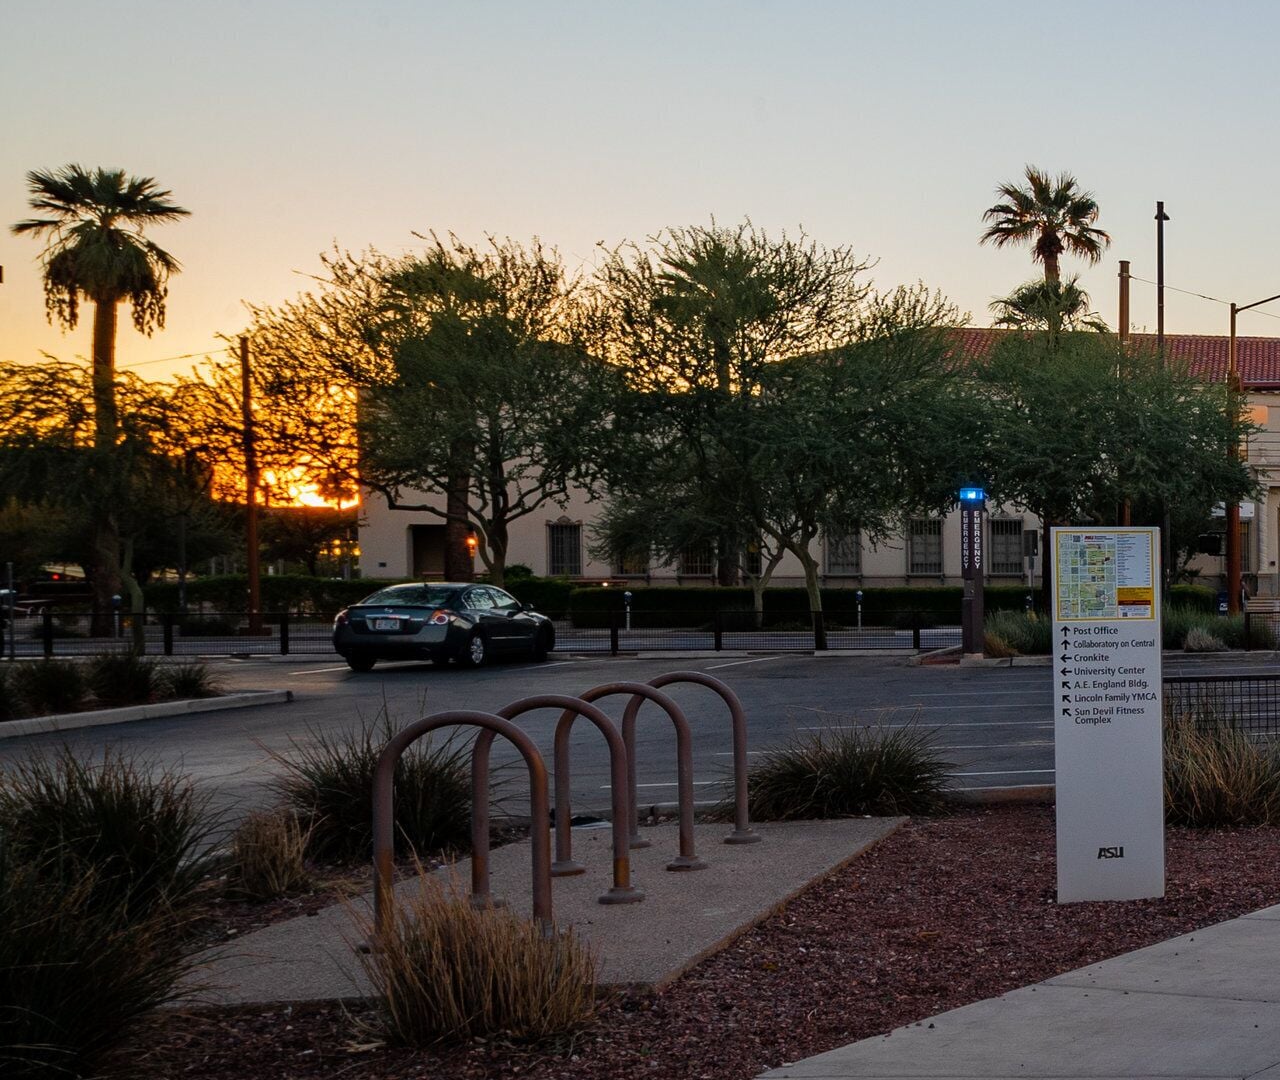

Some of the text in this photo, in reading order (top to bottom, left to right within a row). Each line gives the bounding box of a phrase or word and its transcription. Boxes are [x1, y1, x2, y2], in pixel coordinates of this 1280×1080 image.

[1074, 626, 1118, 635] Post Office
[1074, 640, 1119, 649] Collaboratory
[1131, 639, 1155, 648] Central
[1074, 654, 1110, 662] Cronkite
[1074, 666, 1145, 676] University Center
[1074, 680, 1150, 690] A.E. England Bldg.
[1074, 692, 1157, 704] Lincoln Family YMCA
[1074, 706, 1144, 716] Sun Devil Fitness
[1074, 716, 1112, 726] Complex
[1097, 846, 1124, 859] ASU
